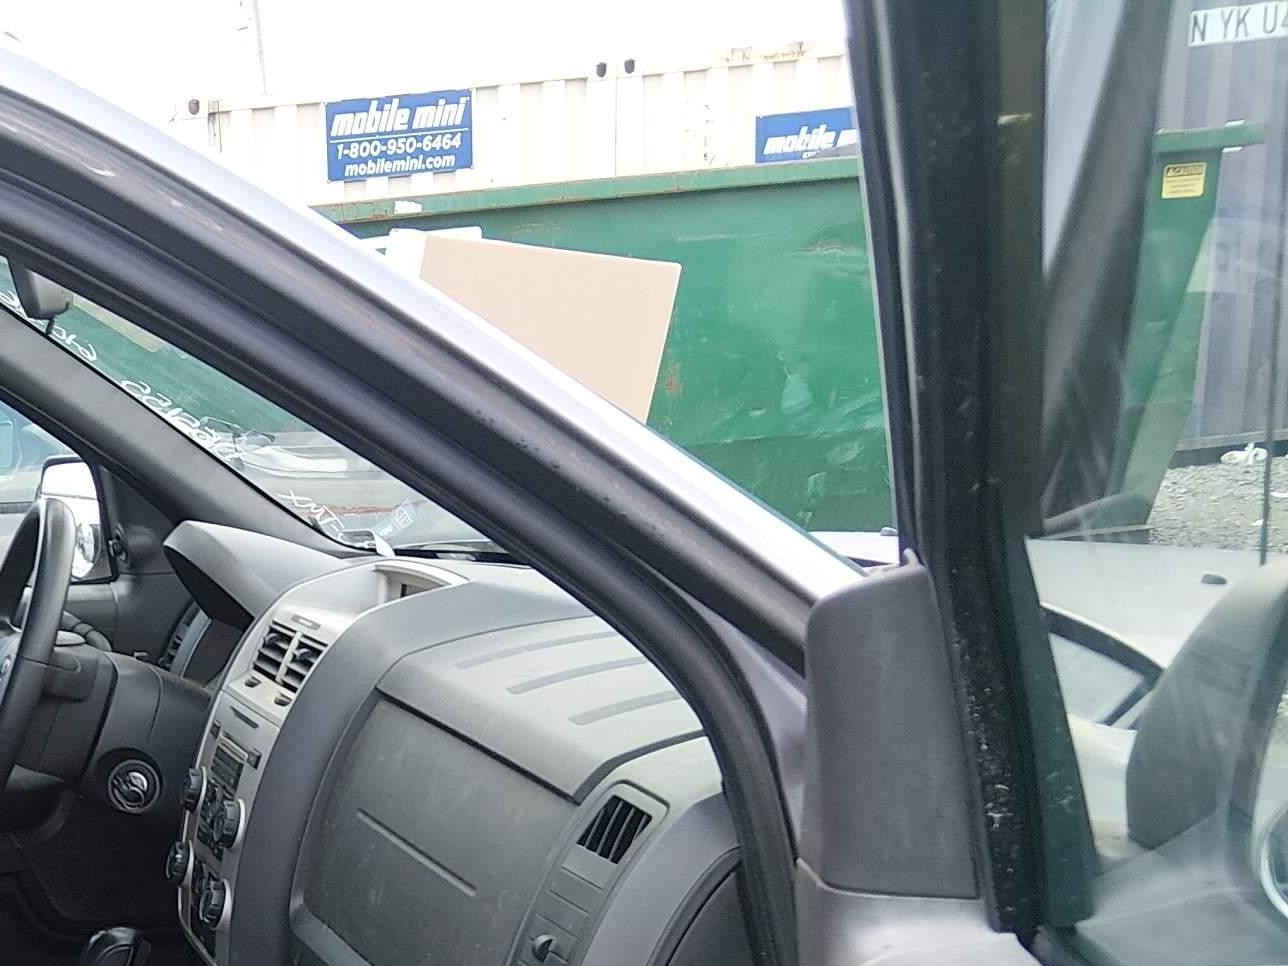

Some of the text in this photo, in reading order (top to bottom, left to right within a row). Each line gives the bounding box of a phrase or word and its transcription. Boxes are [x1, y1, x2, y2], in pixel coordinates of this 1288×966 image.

[330, 96, 468, 137] mobile mini
[337, 133, 462, 160] 1-800-950-6464
[763, 124, 836, 155] mobile
[344, 154, 456, 177] mobilemini.com
